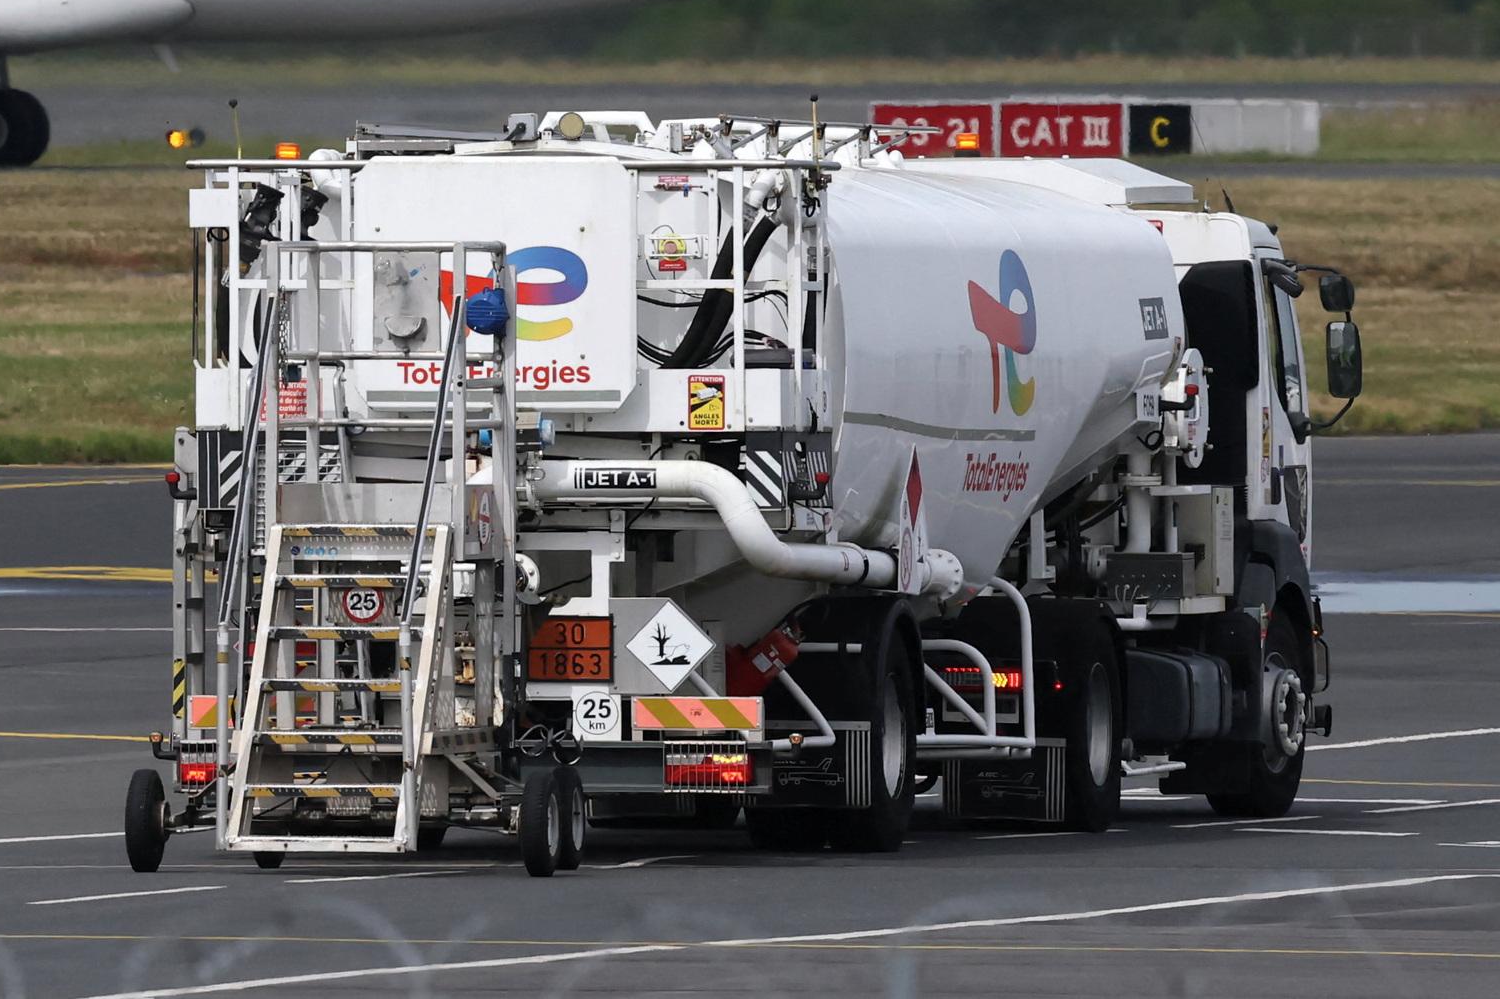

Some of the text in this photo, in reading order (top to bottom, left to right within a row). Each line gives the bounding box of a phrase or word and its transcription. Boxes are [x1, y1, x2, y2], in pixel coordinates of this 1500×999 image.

[1011, 115, 1111, 147] CAT III
[1151, 116, 1171, 146] C
[587, 470, 655, 486] JET A-1
[962, 451, 1030, 502] TotalEnergies
[349, 593, 377, 611] 25
[555, 623, 585, 645] 30
[541, 653, 602, 676] 1863
[583, 699, 611, 719] 25
[589, 721, 606, 731] km
